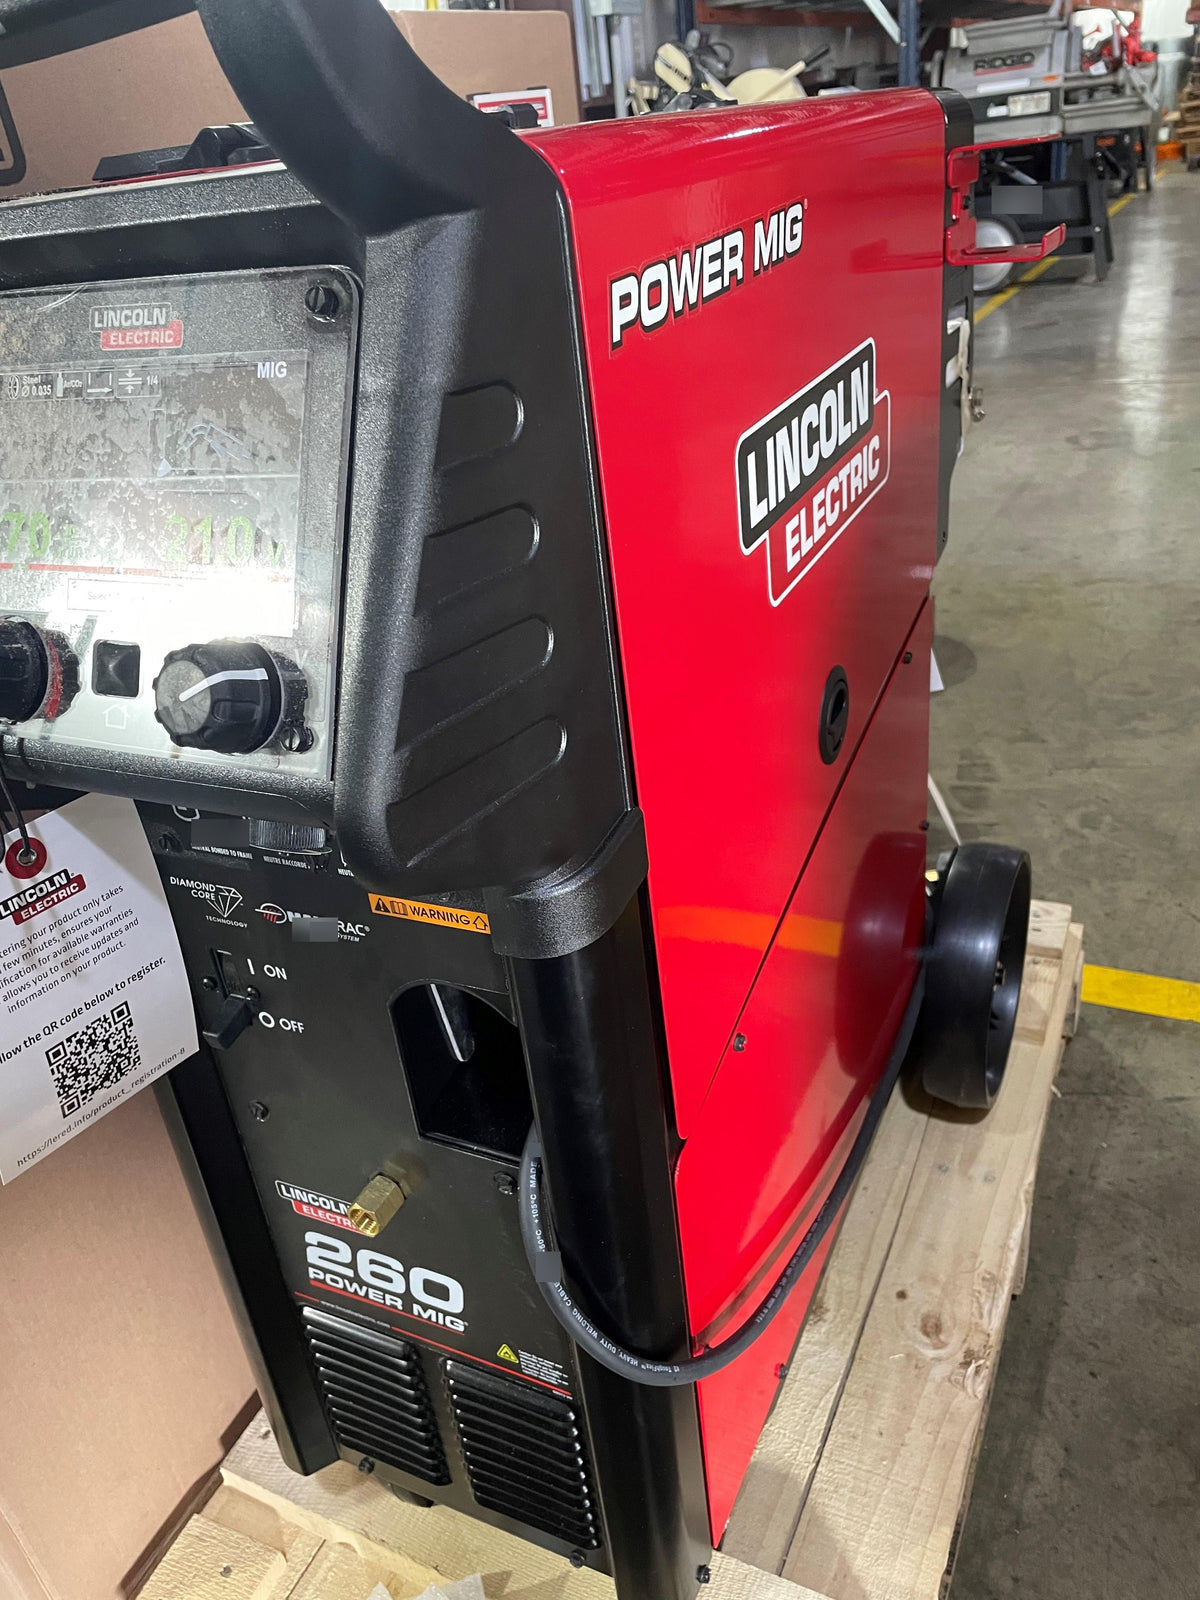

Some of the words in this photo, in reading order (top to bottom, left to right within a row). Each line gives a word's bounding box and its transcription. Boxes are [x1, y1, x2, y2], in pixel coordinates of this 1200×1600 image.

[611, 229, 744, 346] POWER
[753, 203, 803, 274] MIG
[94, 308, 166, 328] LINCOLN
[110, 330, 174, 346] ELECTRIC
[22, 375, 41, 384] Steel
[146, 376, 158, 385] 1/4
[257, 361, 287, 379] MIG
[32, 385, 51, 396] 0.035
[747, 360, 869, 528] LINCOLN
[785, 433, 880, 574] ELECTRIC
[0, 872, 67, 917] LINCOLN
[170, 876, 216, 892] DIAMOND
[191, 889, 216, 901] CORE
[21, 882, 79, 920] ELECTRIC
[26, 927, 46, 944] your
[48, 908, 82, 932] product
[83, 898, 101, 912] only
[101, 885, 124, 901] takes
[205, 915, 248, 928] TECHNOLOGY
[409, 904, 470, 925] WARNING
[0, 963, 37, 989] ification
[38, 955, 51, 967] for
[52, 934, 89, 959] available
[89, 908, 134, 936] warranties
[3, 957, 20, 971] few
[22, 936, 61, 961] minutes,
[61, 918, 94, 939] ensures
[94, 904, 113, 922] your
[2, 982, 31, 1002] allows
[31, 972, 49, 986] you
[50, 964, 59, 974] to
[60, 948, 90, 968] receive
[90, 930, 124, 952] updates
[124, 917, 139, 931] and
[263, 964, 287, 980] ON
[7, 981, 60, 1013] information
[60, 972, 72, 982] on
[72, 960, 92, 976] your
[92, 940, 126, 965] product.
[23, 1031, 42, 1048] the
[42, 1021, 59, 1036] QR
[60, 1007, 84, 1026] code
[84, 988, 114, 1010] below
[114, 979, 126, 991] to
[127, 955, 166, 985] register.
[279, 1018, 304, 1033] OFF
[529, 1161, 538, 1188] MADE
[302, 1204, 356, 1229] ELECTR
[304, 1231, 464, 1313] 260
[308, 1266, 403, 1310] POWER
[413, 1303, 465, 1332] MIG
[554, 1281, 572, 1306] CABLE
[572, 1308, 598, 1339] WELDING
[600, 1338, 617, 1353] DUTY
